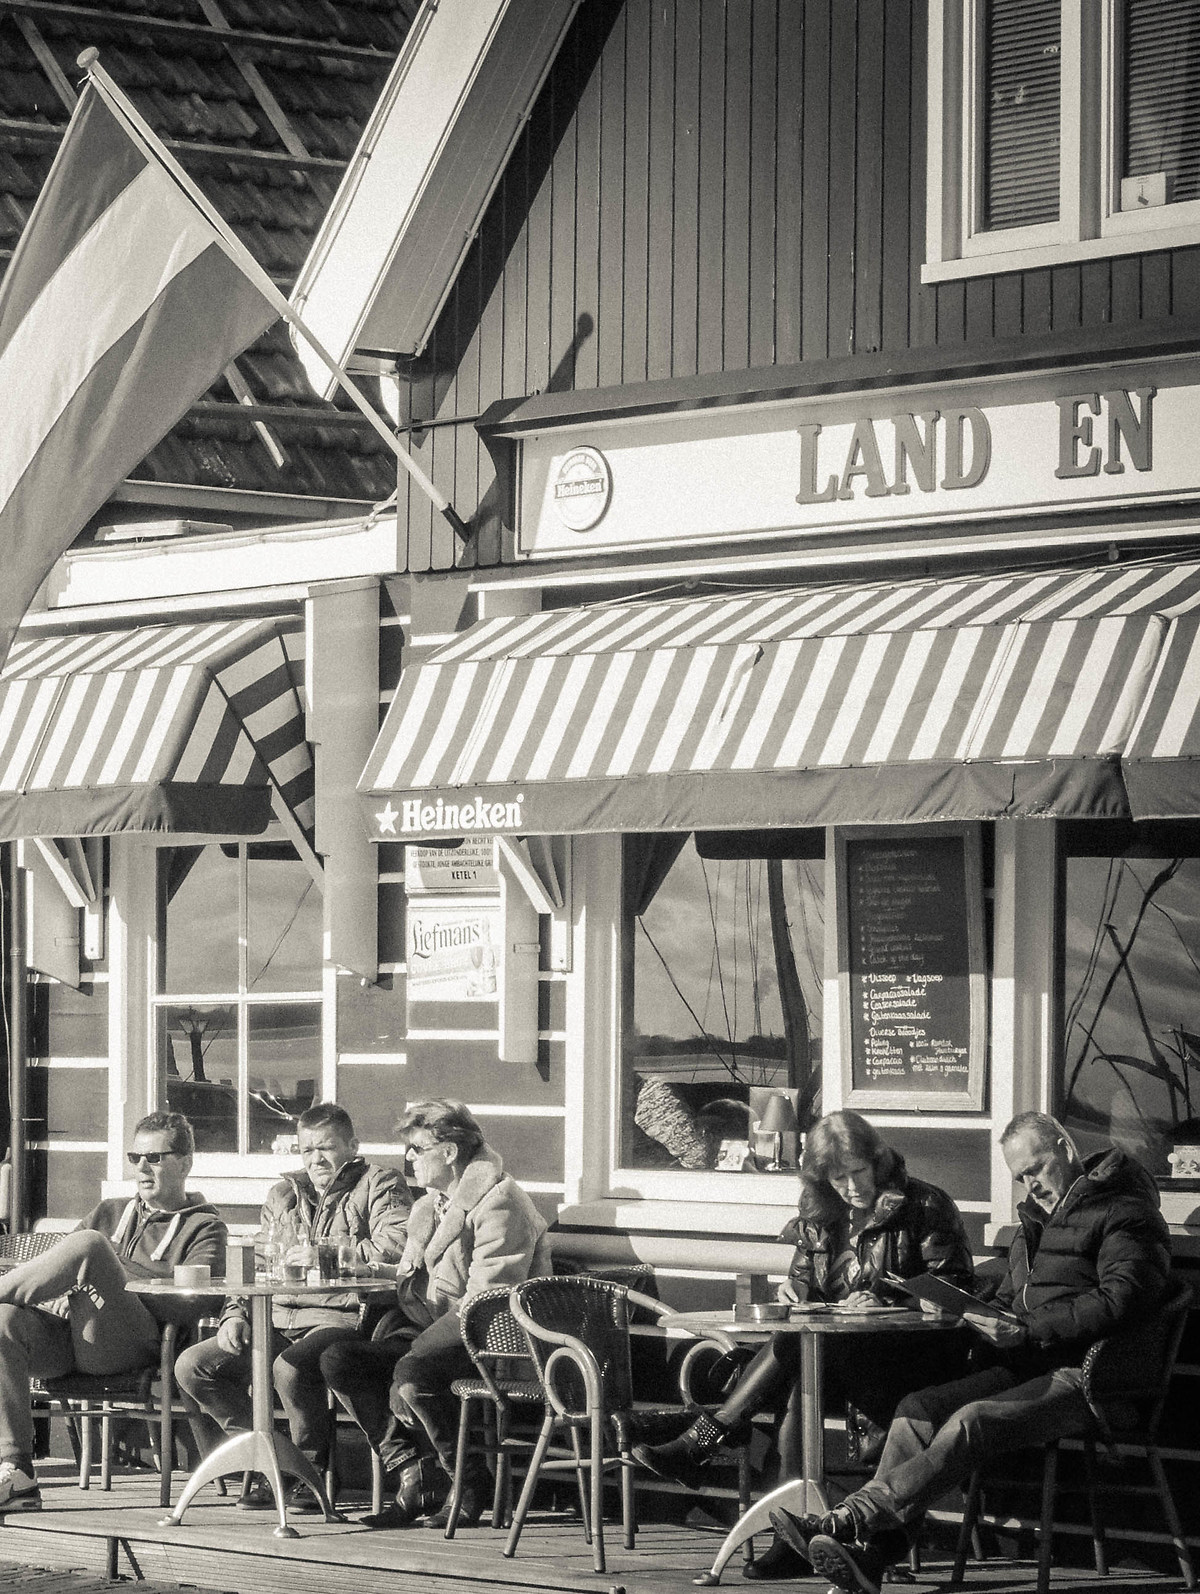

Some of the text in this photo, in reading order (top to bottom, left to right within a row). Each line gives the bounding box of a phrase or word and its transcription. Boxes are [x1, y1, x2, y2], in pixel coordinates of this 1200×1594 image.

[796, 386, 1157, 504] LAND EN
[557, 481, 602, 497] Heineken
[400, 796, 523, 832] Heineken
[451, 870, 472, 880] KETEL
[412, 920, 481, 959] Liefmans
